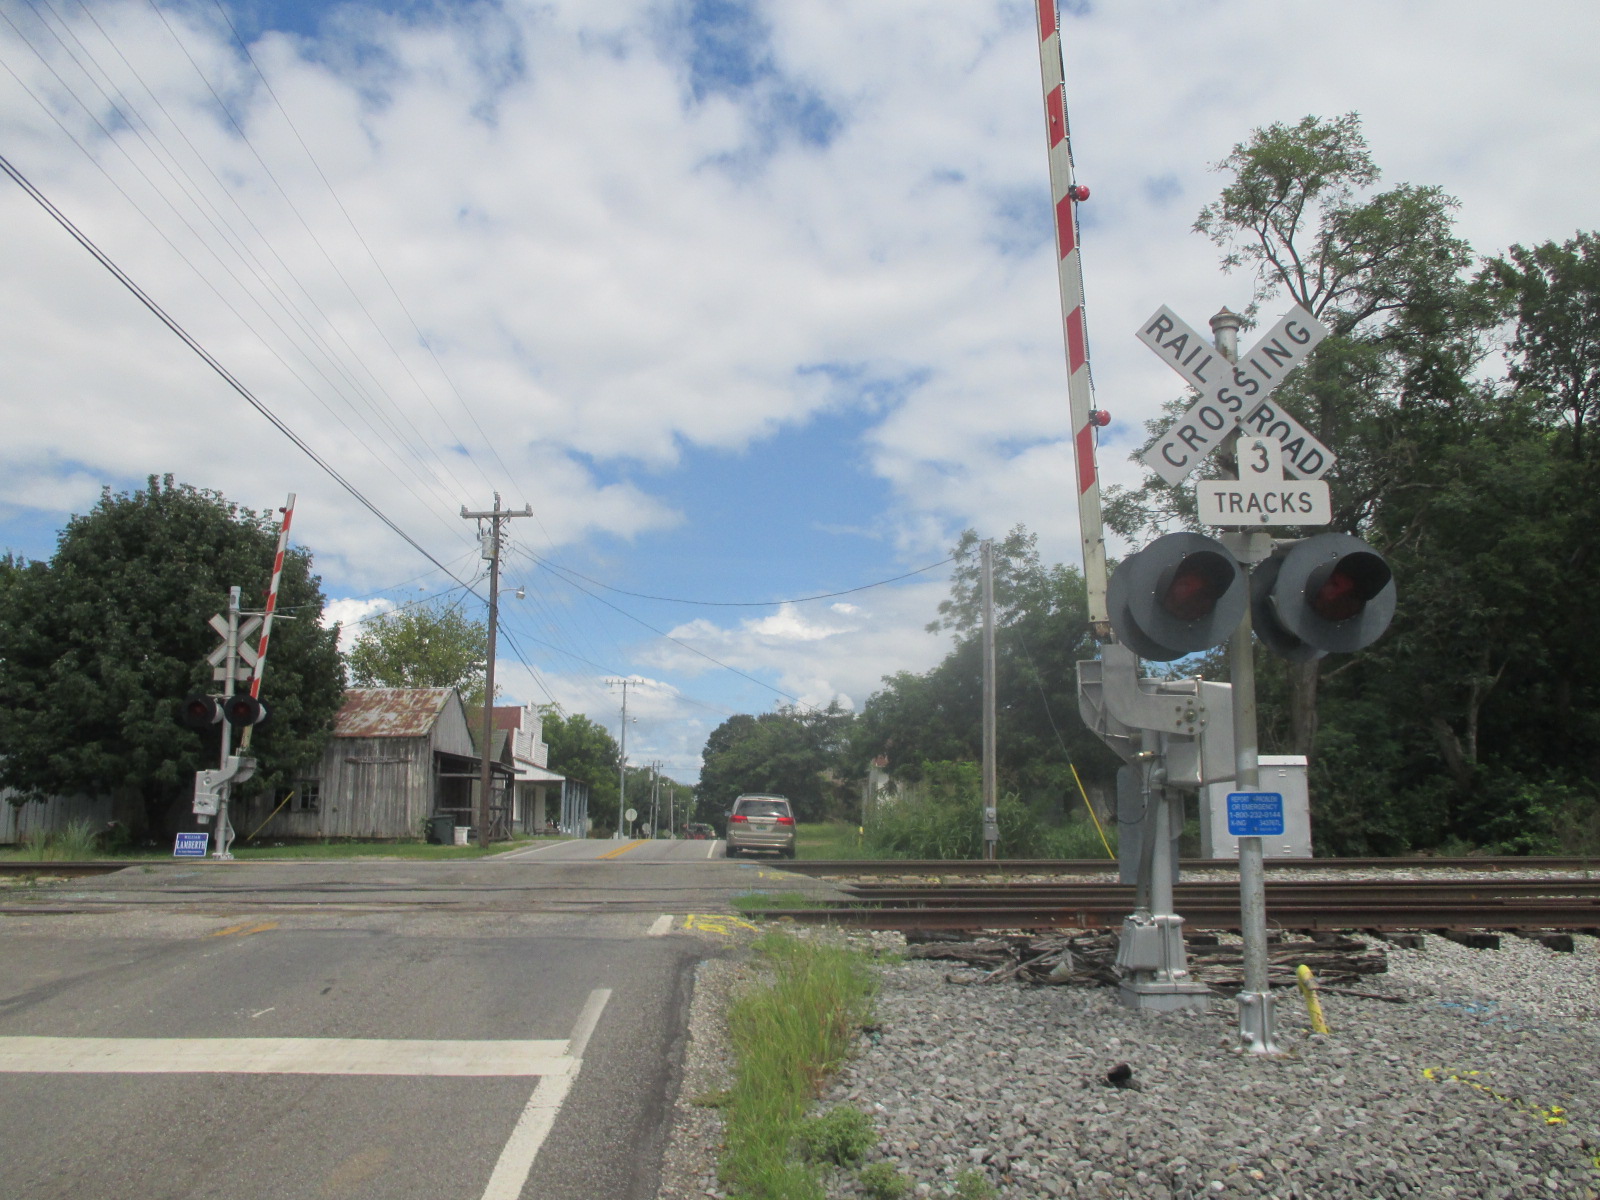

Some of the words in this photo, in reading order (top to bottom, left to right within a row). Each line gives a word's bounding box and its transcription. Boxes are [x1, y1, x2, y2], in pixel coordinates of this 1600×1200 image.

[1145, 313, 1213, 384] RAIL
[1247, 403, 1324, 475] ROAD
[1161, 320, 1312, 468] CROSSING
[1250, 443, 1270, 474] 3
[1214, 491, 1313, 514] TRACKS
[176, 840, 206, 849] LAMBERTH
